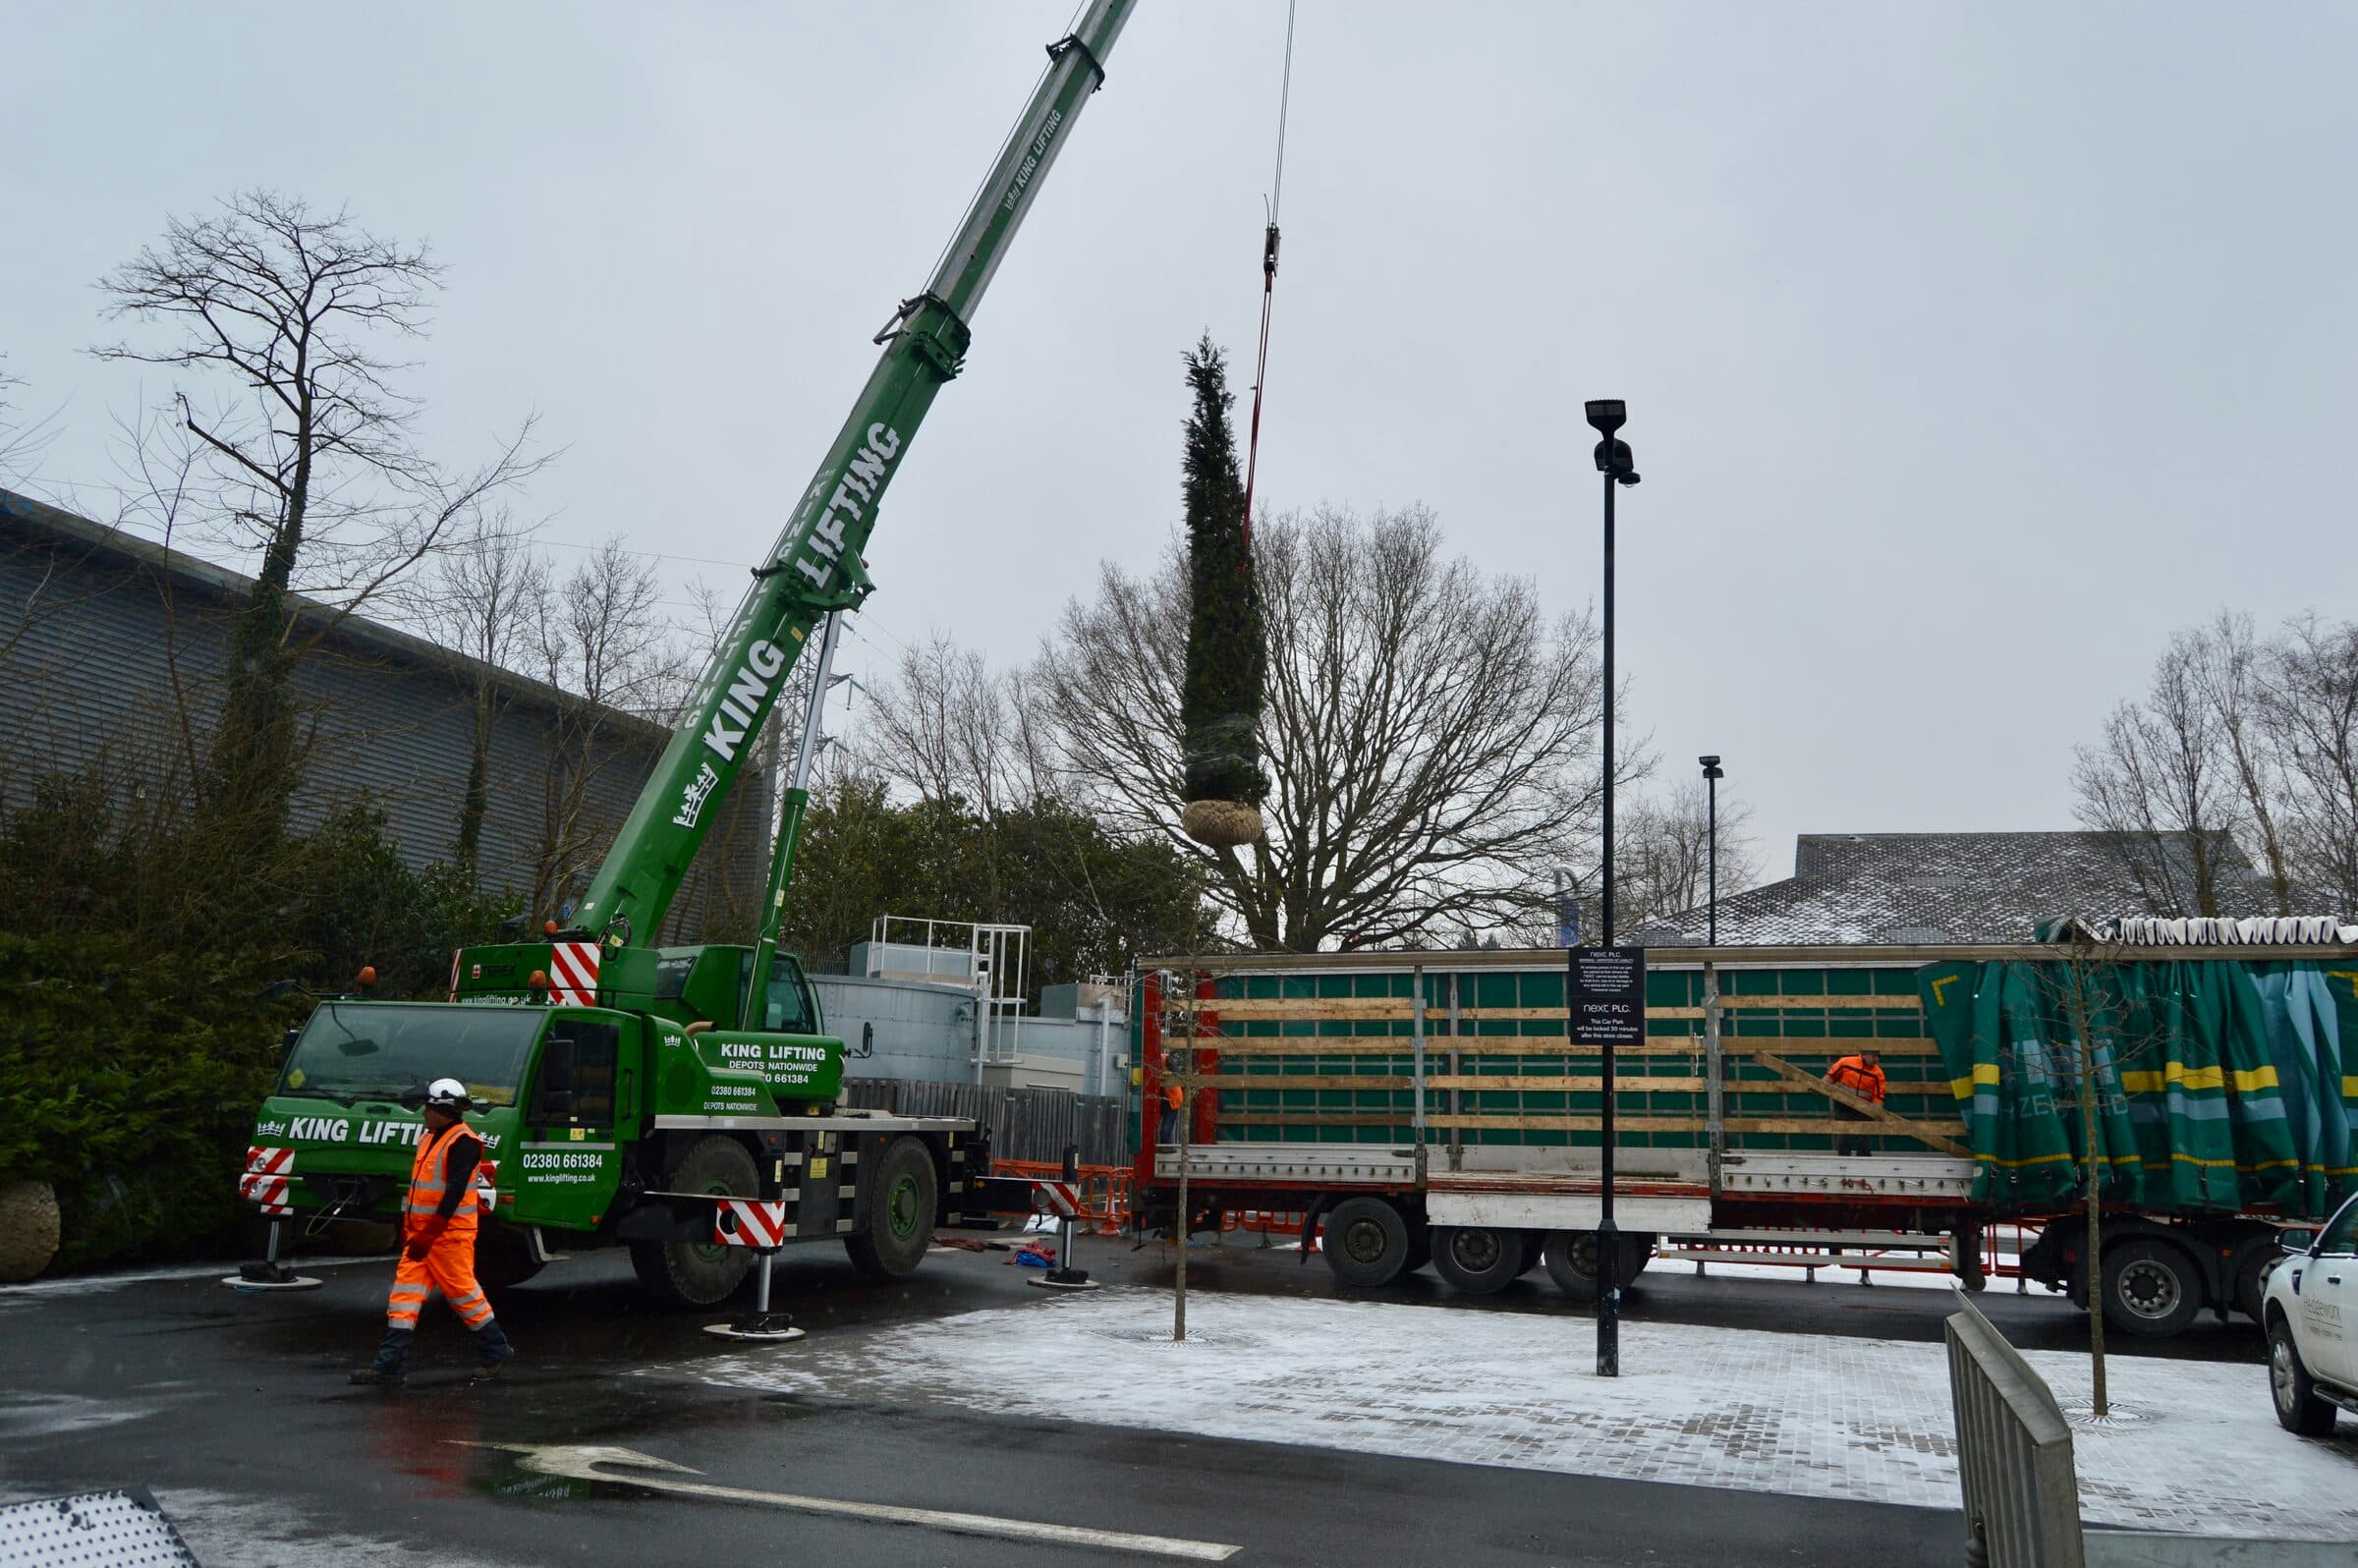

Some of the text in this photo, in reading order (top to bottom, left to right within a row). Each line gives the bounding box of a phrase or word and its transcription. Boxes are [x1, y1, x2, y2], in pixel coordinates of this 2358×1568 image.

[1016, 109, 1061, 188] KING LIFTING
[702, 421, 901, 762] KING LIFTING
[1583, 1004, 1609, 1013] next
[721, 1043, 826, 1061] KING LIFTING
[729, 1061, 818, 1073] DEPOTS NATIONWIDE
[774, 1074, 809, 1085] 661384
[711, 1086, 757, 1097] 02380 661384
[703, 1101, 758, 1112] DEPOTS NATIONWIDE
[288, 1117, 350, 1143] KING
[523, 1153, 603, 1169] 02380 661384
[528, 1172, 596, 1184] www.kinglifting.co.uk
